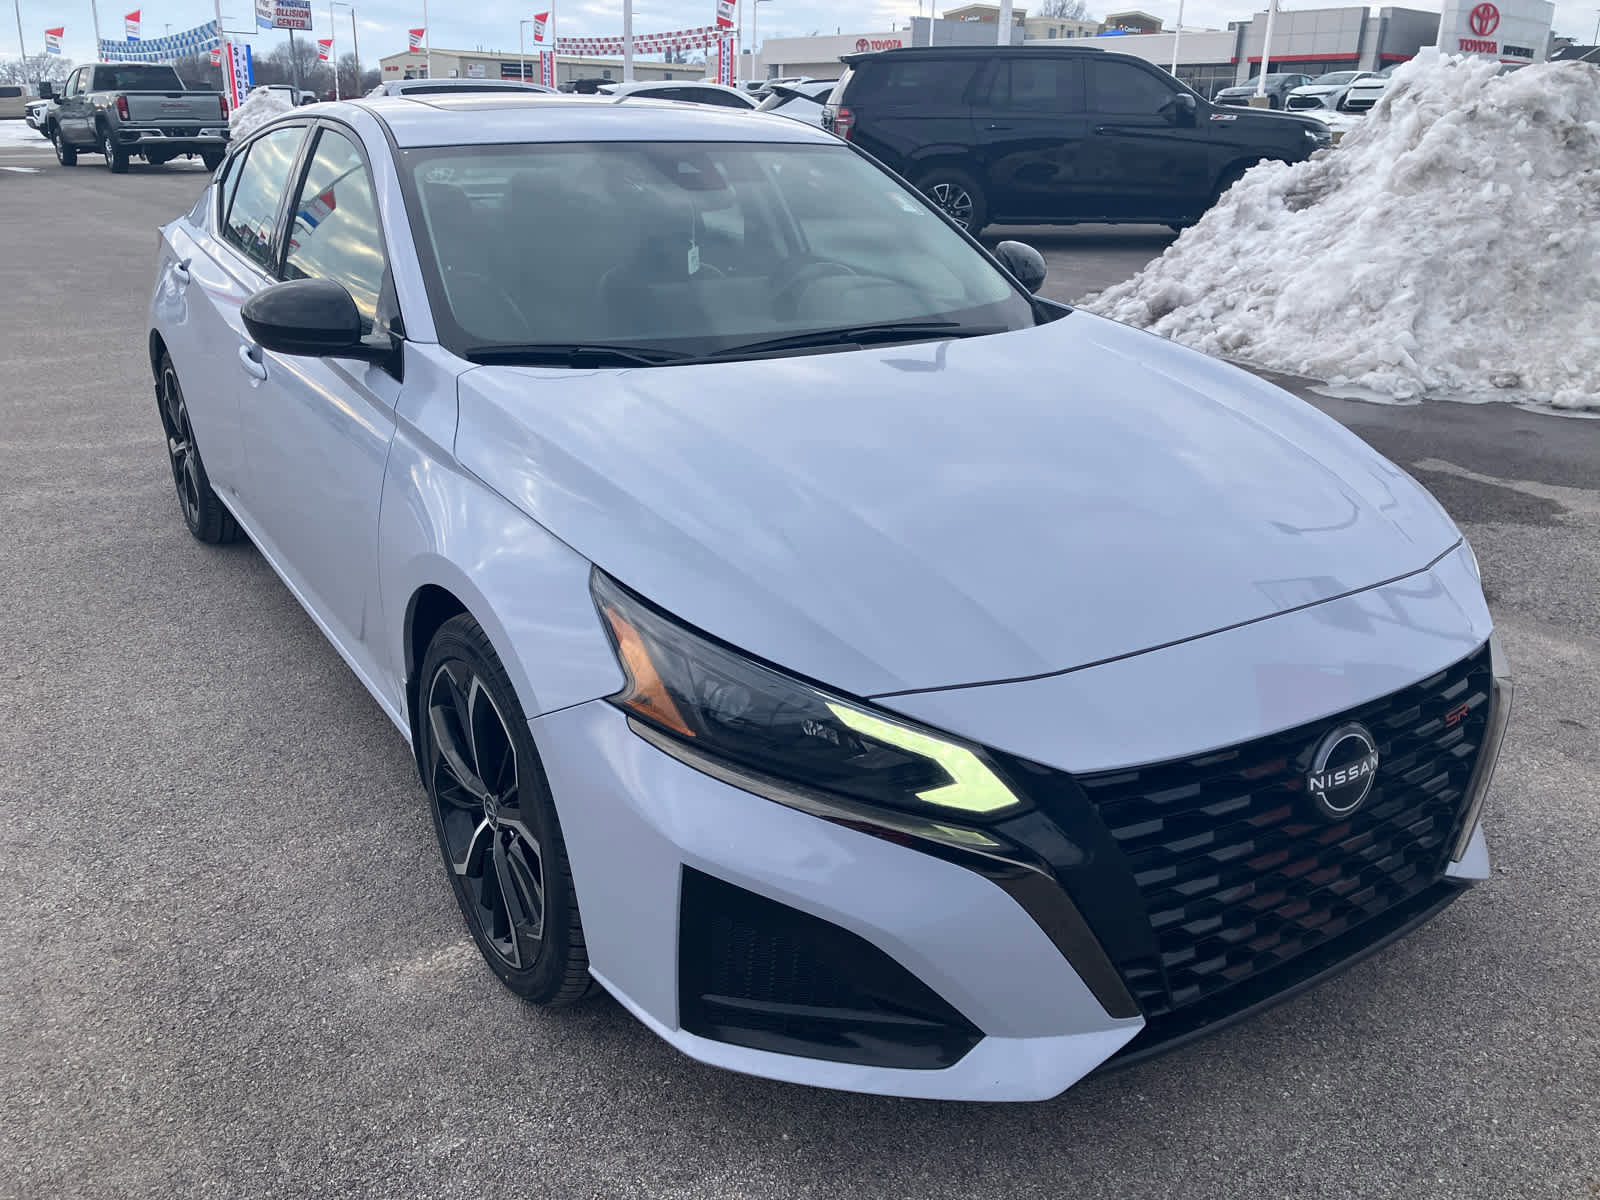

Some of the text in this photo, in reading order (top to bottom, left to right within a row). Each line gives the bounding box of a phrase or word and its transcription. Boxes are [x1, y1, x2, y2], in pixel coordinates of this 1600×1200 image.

[277, 18, 306, 27] CENTER
[871, 39, 903, 51] TOYOTA
[1459, 38, 1497, 54] TOYOTA
[1446, 704, 1469, 727] SR
[1310, 752, 1378, 791] NISSAN
